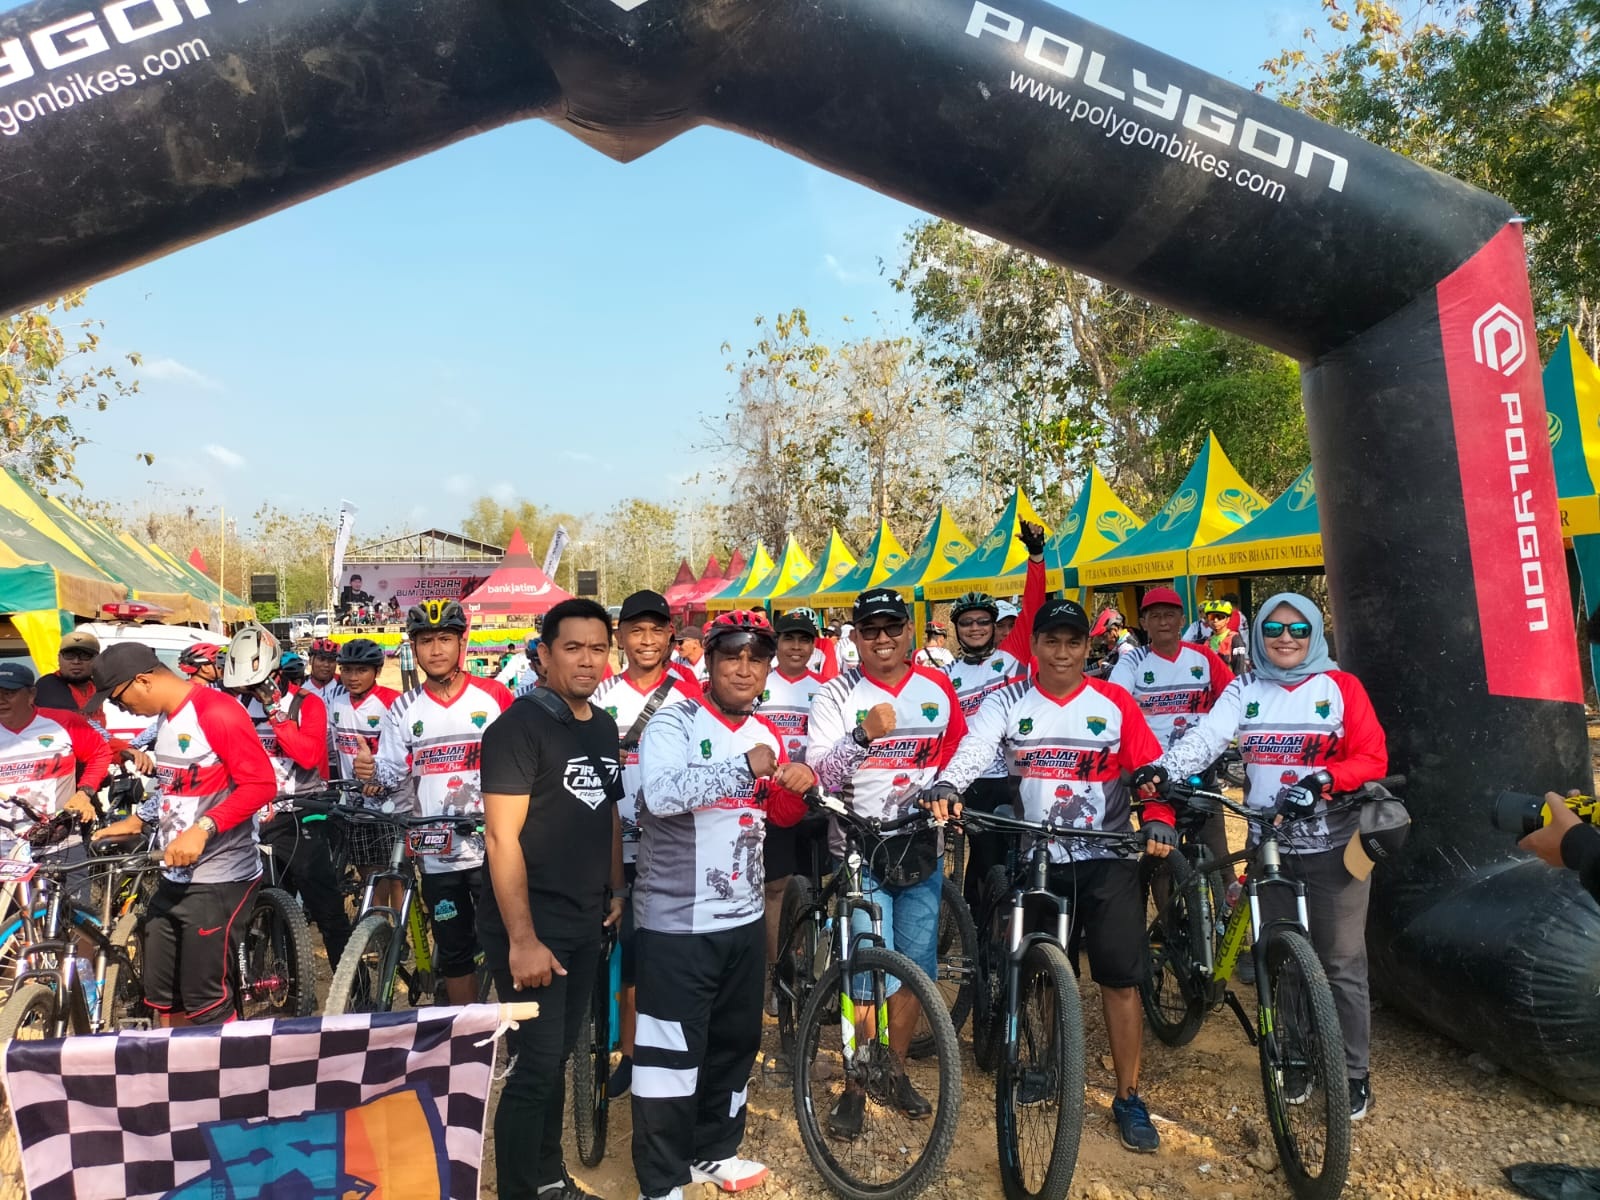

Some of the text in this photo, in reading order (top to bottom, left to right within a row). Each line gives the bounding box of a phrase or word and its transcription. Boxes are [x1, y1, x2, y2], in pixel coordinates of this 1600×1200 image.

[965, 1, 1348, 193] POLYGON
[1009, 70, 1286, 202] www.polygonbikes.com
[1501, 393, 1549, 632] POLYGON
[414, 579, 461, 589] JELAJAH
[1243, 734, 1306, 746] JELAJAH
[868, 741, 917, 755] ELAJAH
[1022, 749, 1080, 761] JELAJAH
[564, 764, 619, 776] FIRT
